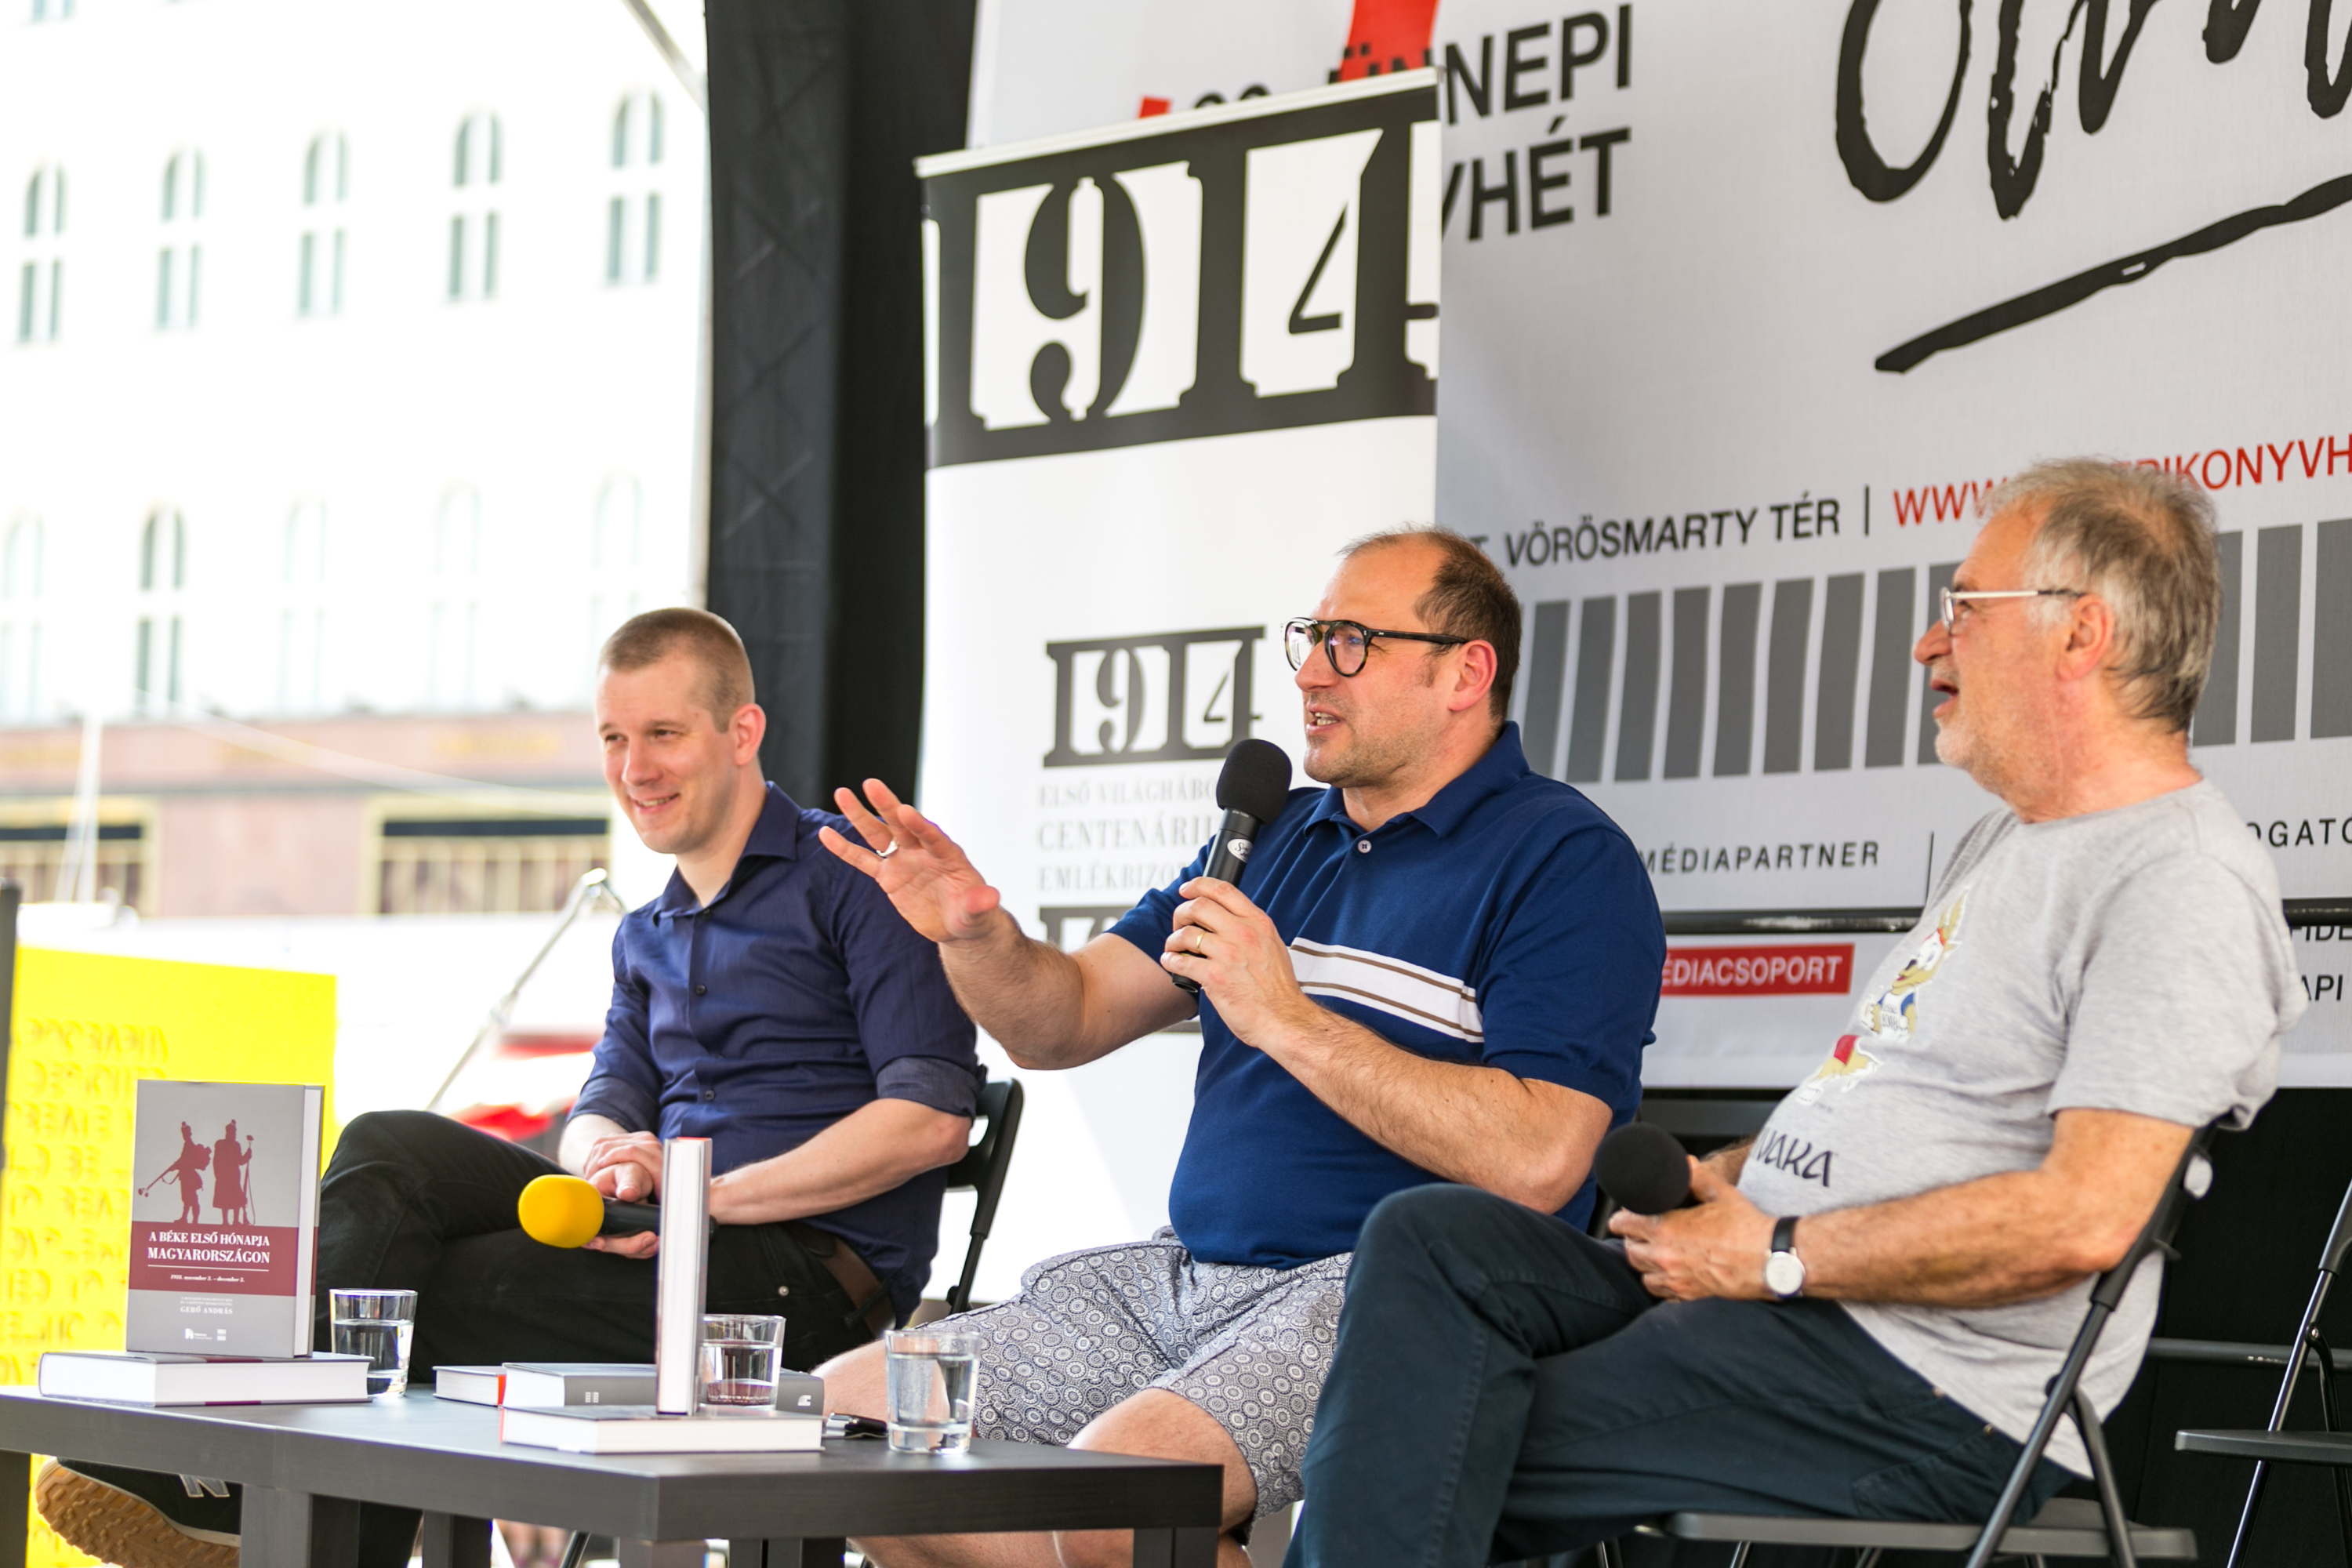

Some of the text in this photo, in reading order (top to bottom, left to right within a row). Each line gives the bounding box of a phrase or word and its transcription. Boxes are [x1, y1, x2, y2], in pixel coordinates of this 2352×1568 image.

[1328, 3, 1632, 126] NEPI
[1504, 507, 1758, 568] VÖRÖSMARTY
[1769, 491, 1840, 542] TÉR
[1043, 625, 1267, 768] 1914
[1040, 779, 1091, 806] ELSŐ
[1040, 858, 1189, 892] EMLÉKBIZO
[149, 1230, 270, 1247] A BÉKE ELSŐ HÓNAPJA
[147, 1247, 270, 1264] MAGYARORSZÁGON
[203, 1306, 234, 1316] ANDRÁS
